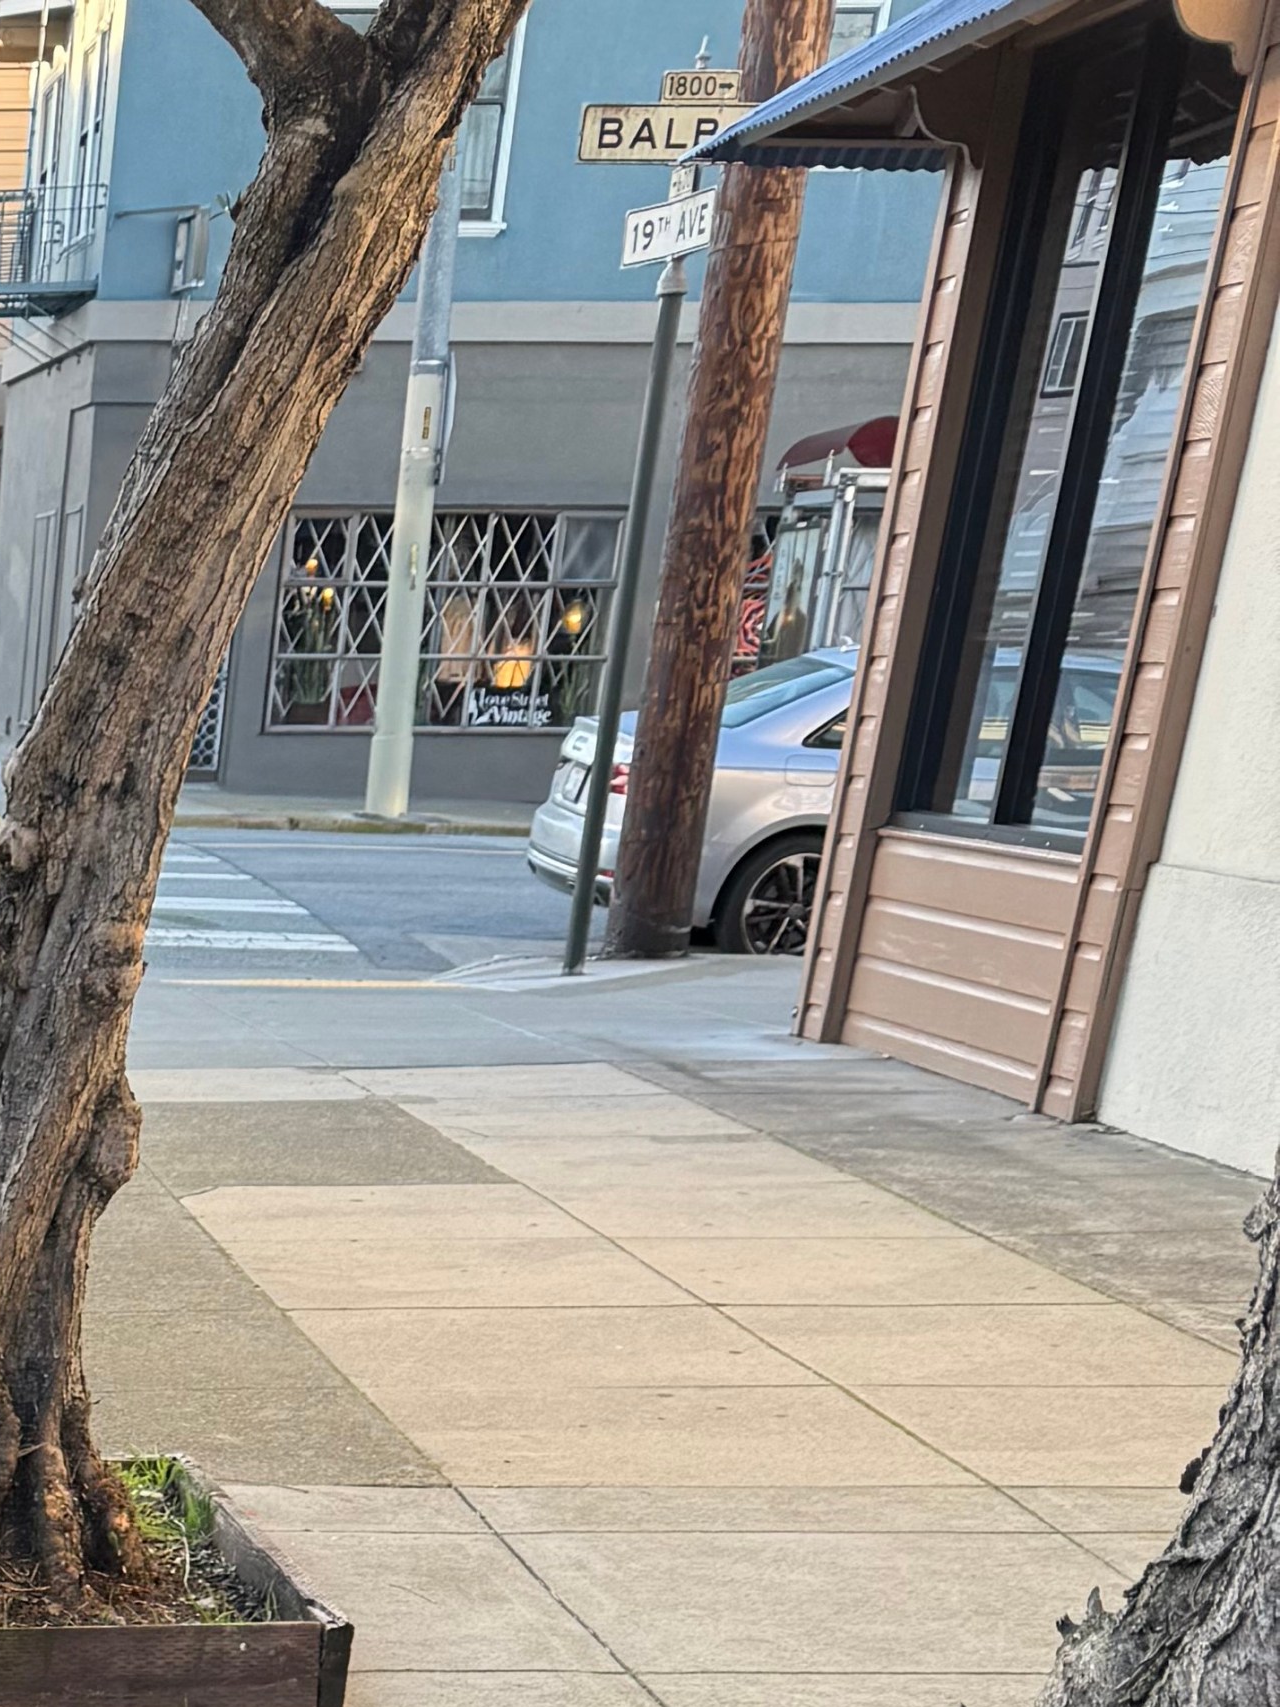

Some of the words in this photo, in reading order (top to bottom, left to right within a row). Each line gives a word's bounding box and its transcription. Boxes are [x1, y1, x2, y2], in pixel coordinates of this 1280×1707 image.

[667, 75, 717, 98] 1800
[632, 214, 672, 254] 19TH
[675, 202, 709, 244] AVE
[511, 691, 550, 706] Stret
